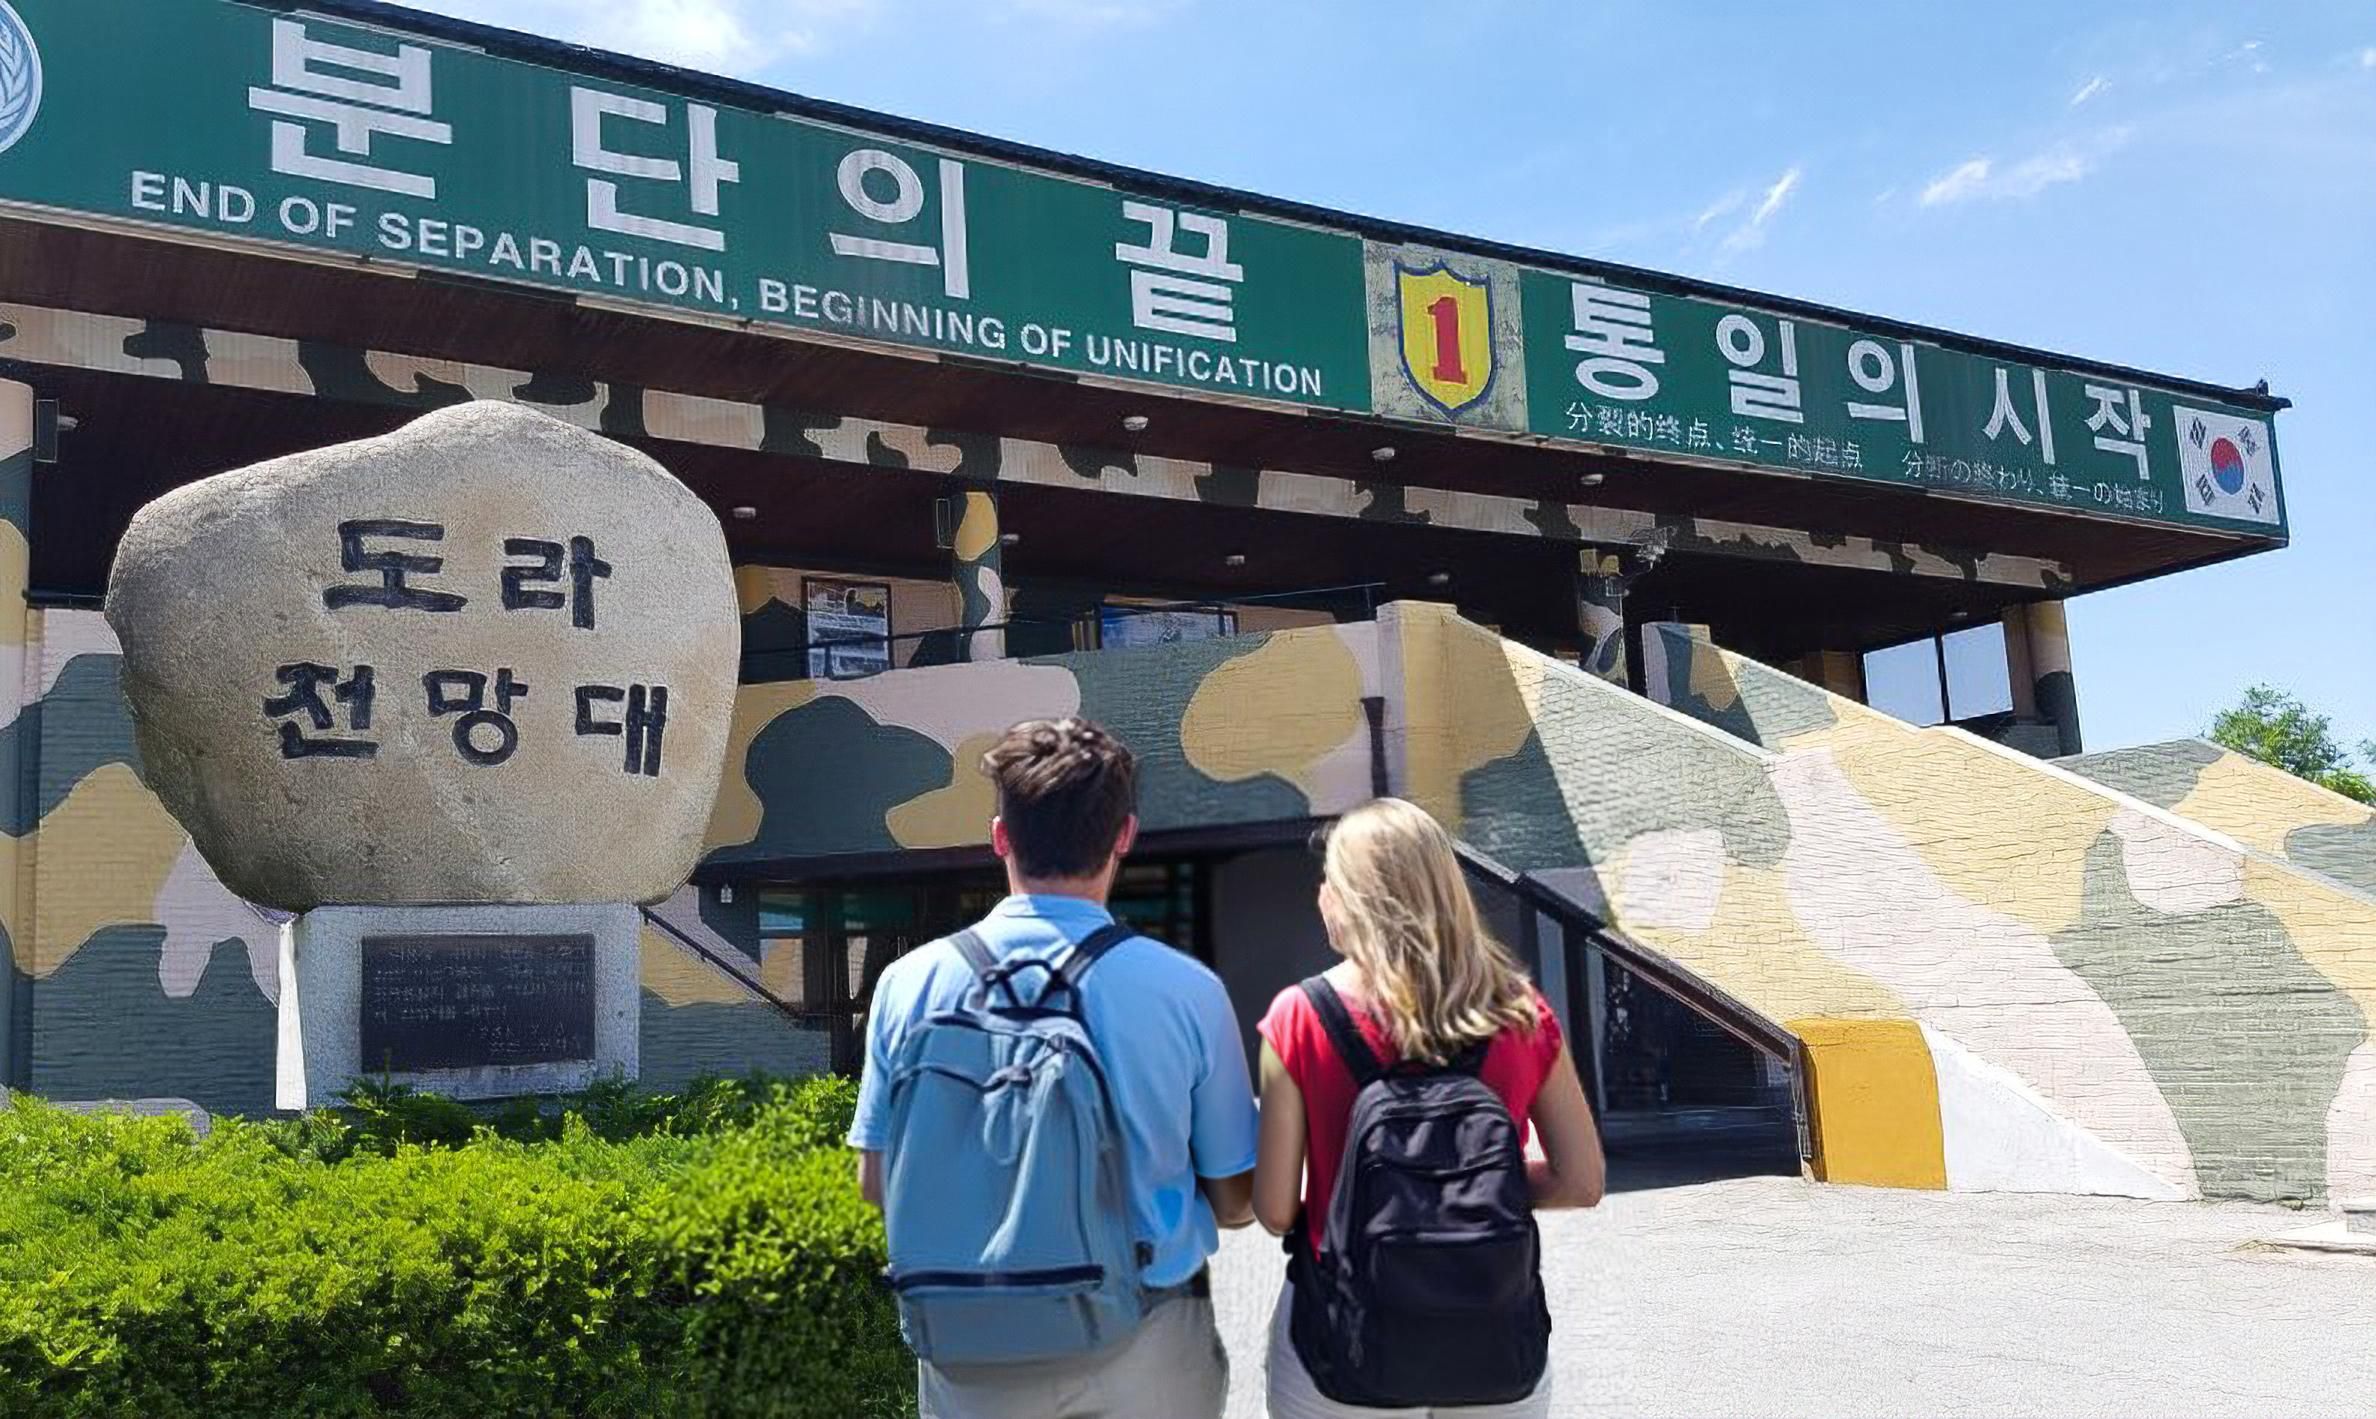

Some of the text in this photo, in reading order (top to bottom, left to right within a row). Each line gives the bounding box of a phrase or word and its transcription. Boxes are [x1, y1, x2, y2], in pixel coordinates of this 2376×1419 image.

[131, 171, 1321, 396] END OF SEPARATION, BEGINNING OF UNIFICATION
[1116, 201, 1243, 342] 끝
[1426, 296, 1467, 385] 1
[323, 519, 612, 630] 도라
[263, 661, 669, 777] 전망대
